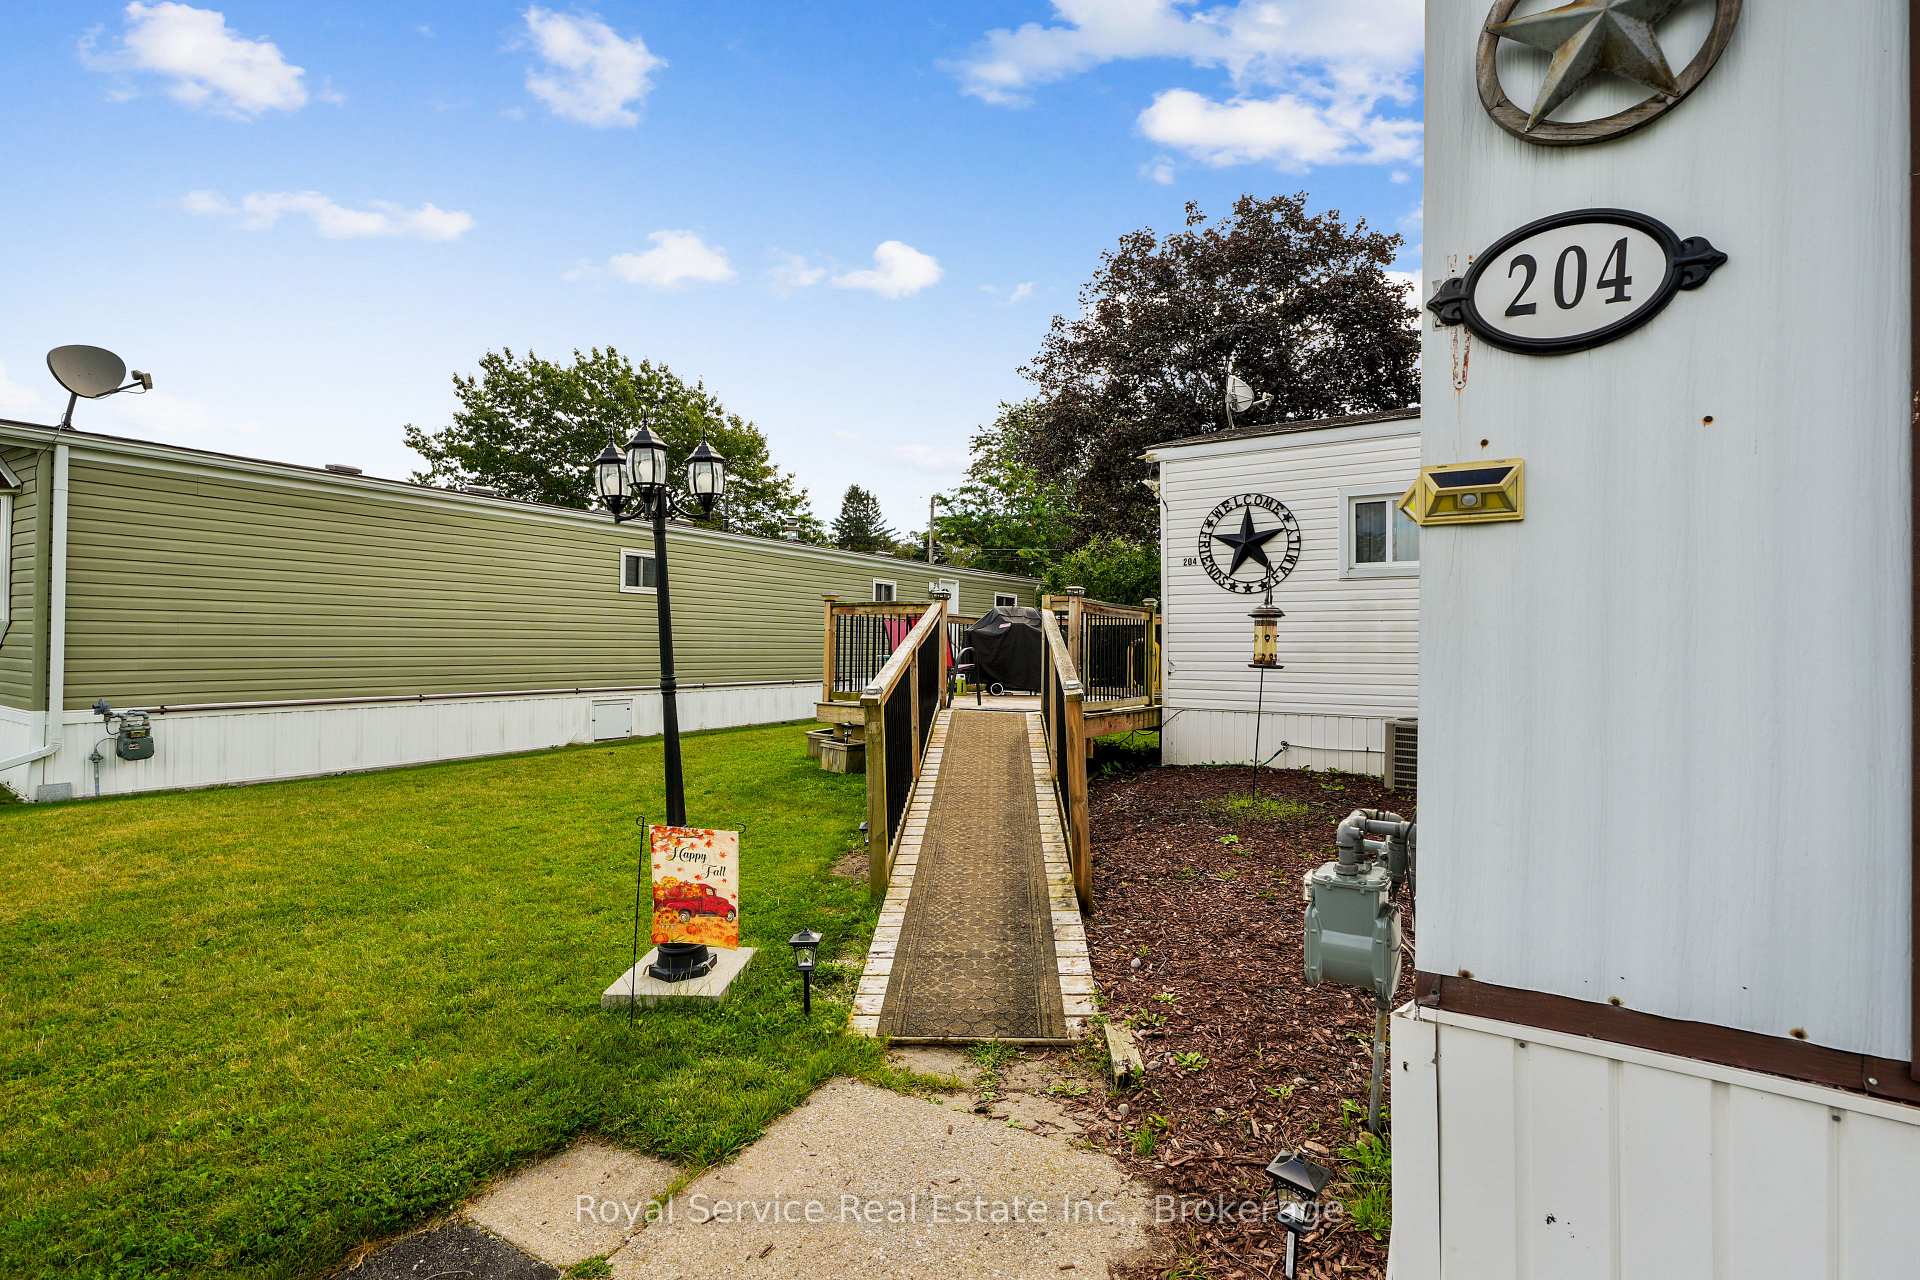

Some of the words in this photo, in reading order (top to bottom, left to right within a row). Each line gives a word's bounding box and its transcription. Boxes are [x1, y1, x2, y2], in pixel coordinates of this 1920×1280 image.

[1504, 237, 1632, 316] 204
[1211, 494, 1284, 520] WELCOME
[1183, 558, 1197, 567] 204
[1199, 530, 1229, 586] FRIENDS
[1271, 528, 1300, 584] FAMILY
[666, 846, 706, 863] Happy
[702, 864, 726, 878] Fall
